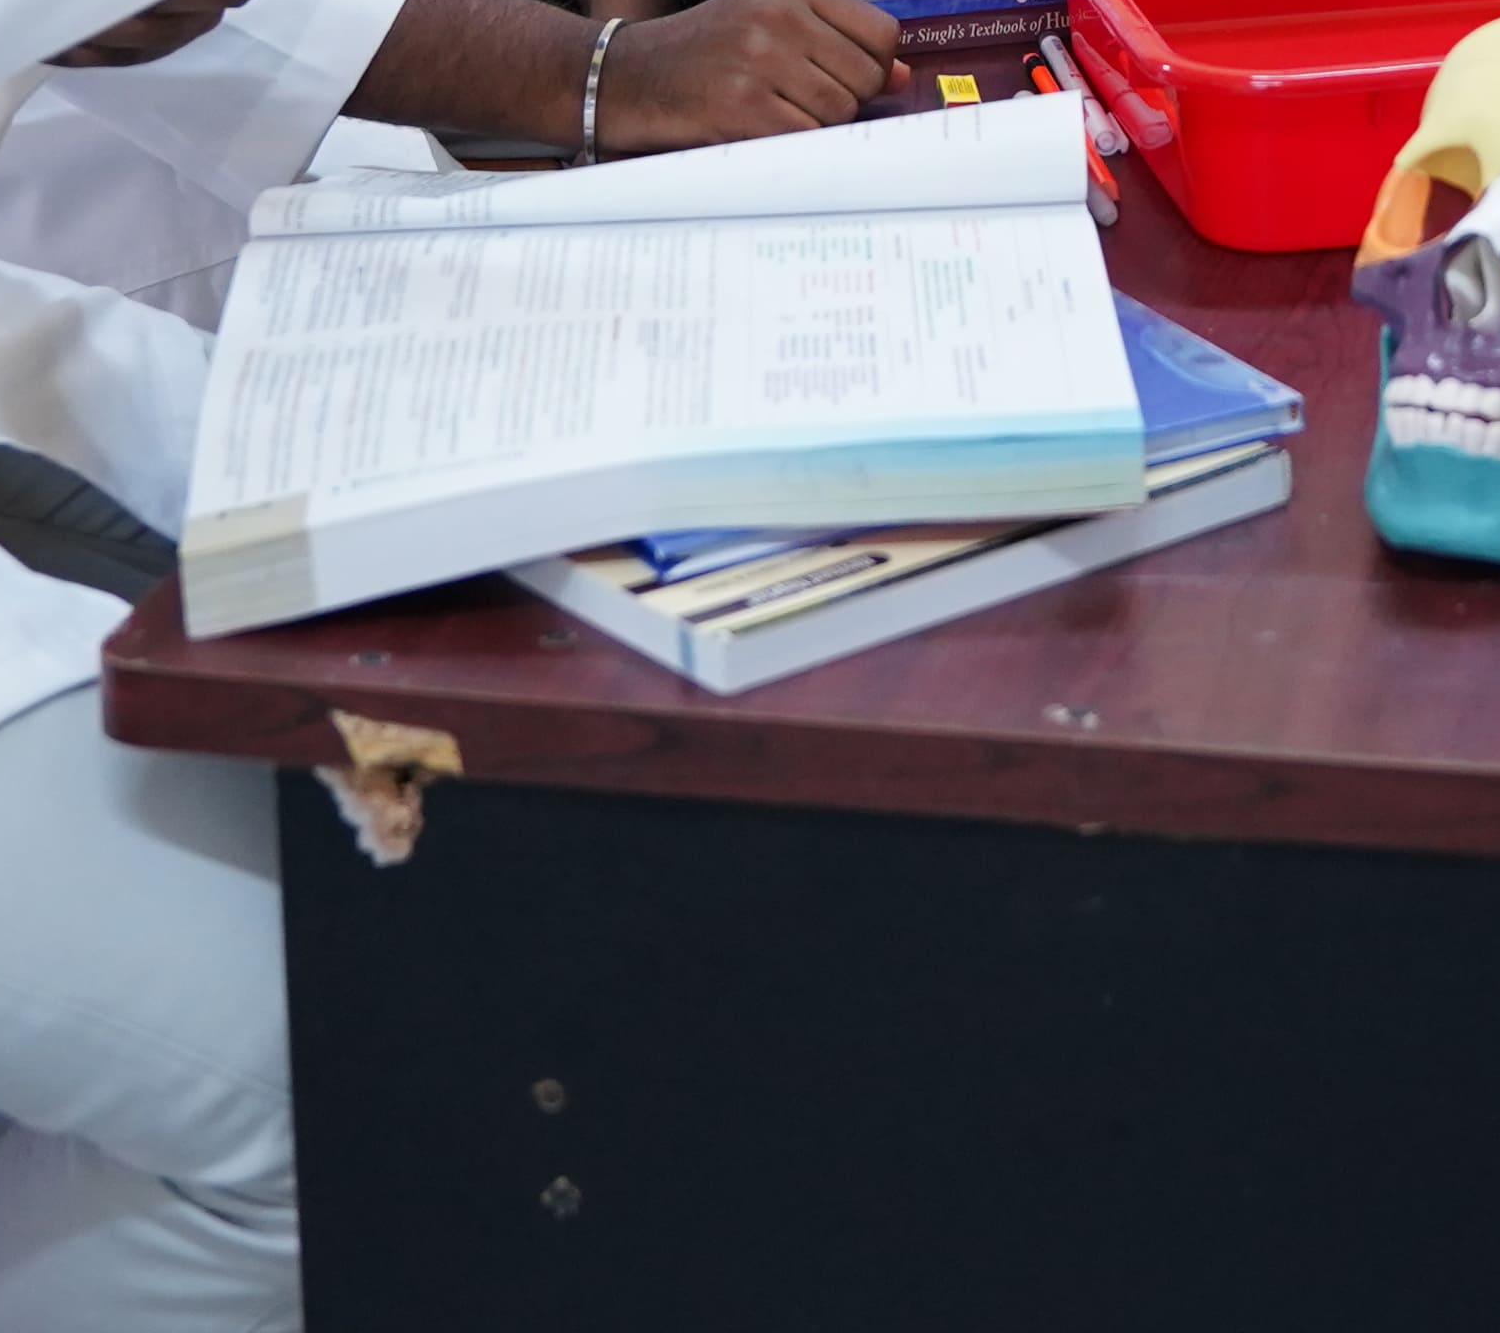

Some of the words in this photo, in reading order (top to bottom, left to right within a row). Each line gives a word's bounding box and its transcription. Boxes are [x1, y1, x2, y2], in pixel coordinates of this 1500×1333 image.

[916, 23, 966, 46] Singh's
[968, 17, 1027, 38] Textbook
[1030, 15, 1045, 36] of
